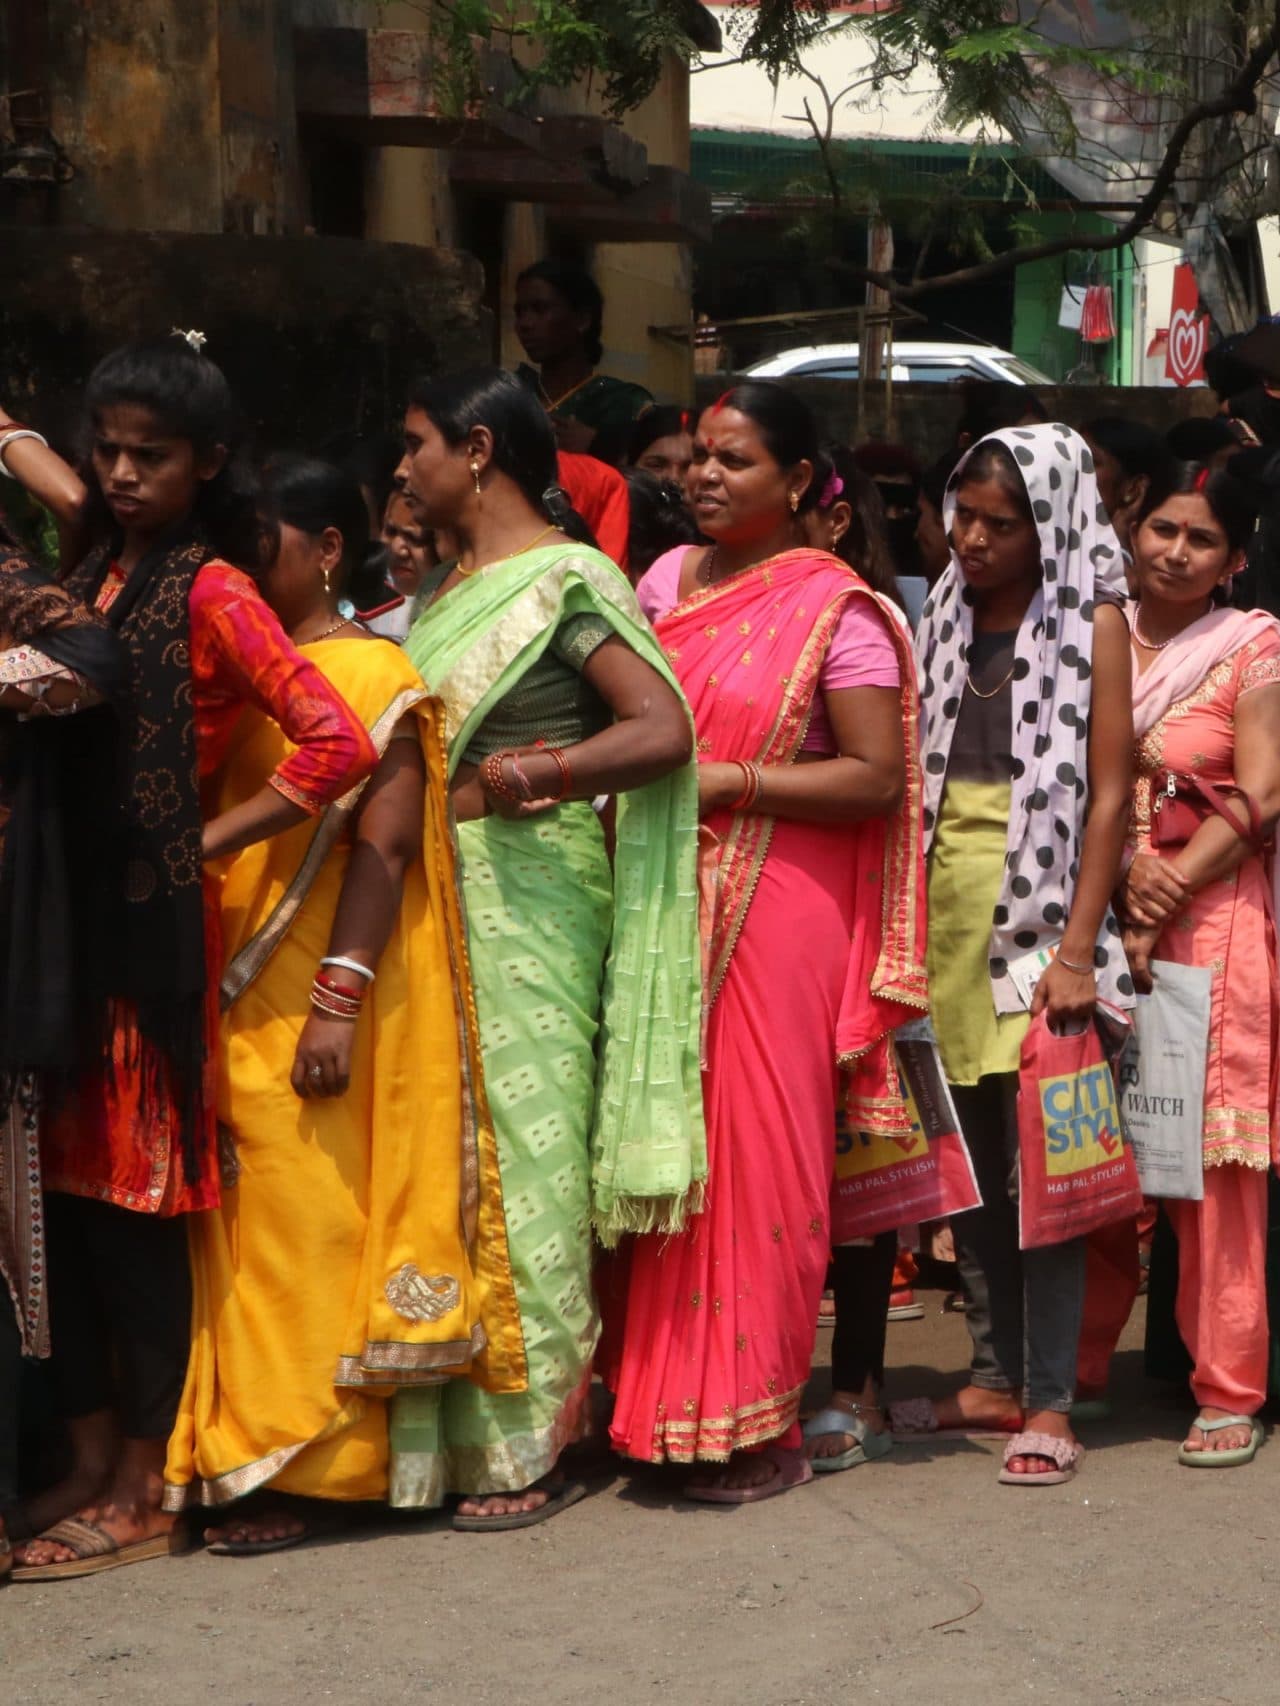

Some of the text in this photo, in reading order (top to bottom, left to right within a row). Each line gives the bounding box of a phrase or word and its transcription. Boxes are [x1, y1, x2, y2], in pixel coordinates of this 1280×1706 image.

[1043, 1069, 1114, 1121] CITI
[1128, 1093, 1184, 1117] WATCH
[1047, 1106, 1119, 1156] STYLE
[839, 1159, 936, 1197] HAR PAL STYLISH
[1047, 1183, 1070, 1194] HAR
[1072, 1177, 1089, 1189] PAL
[1091, 1163, 1126, 1184] STYLISH
